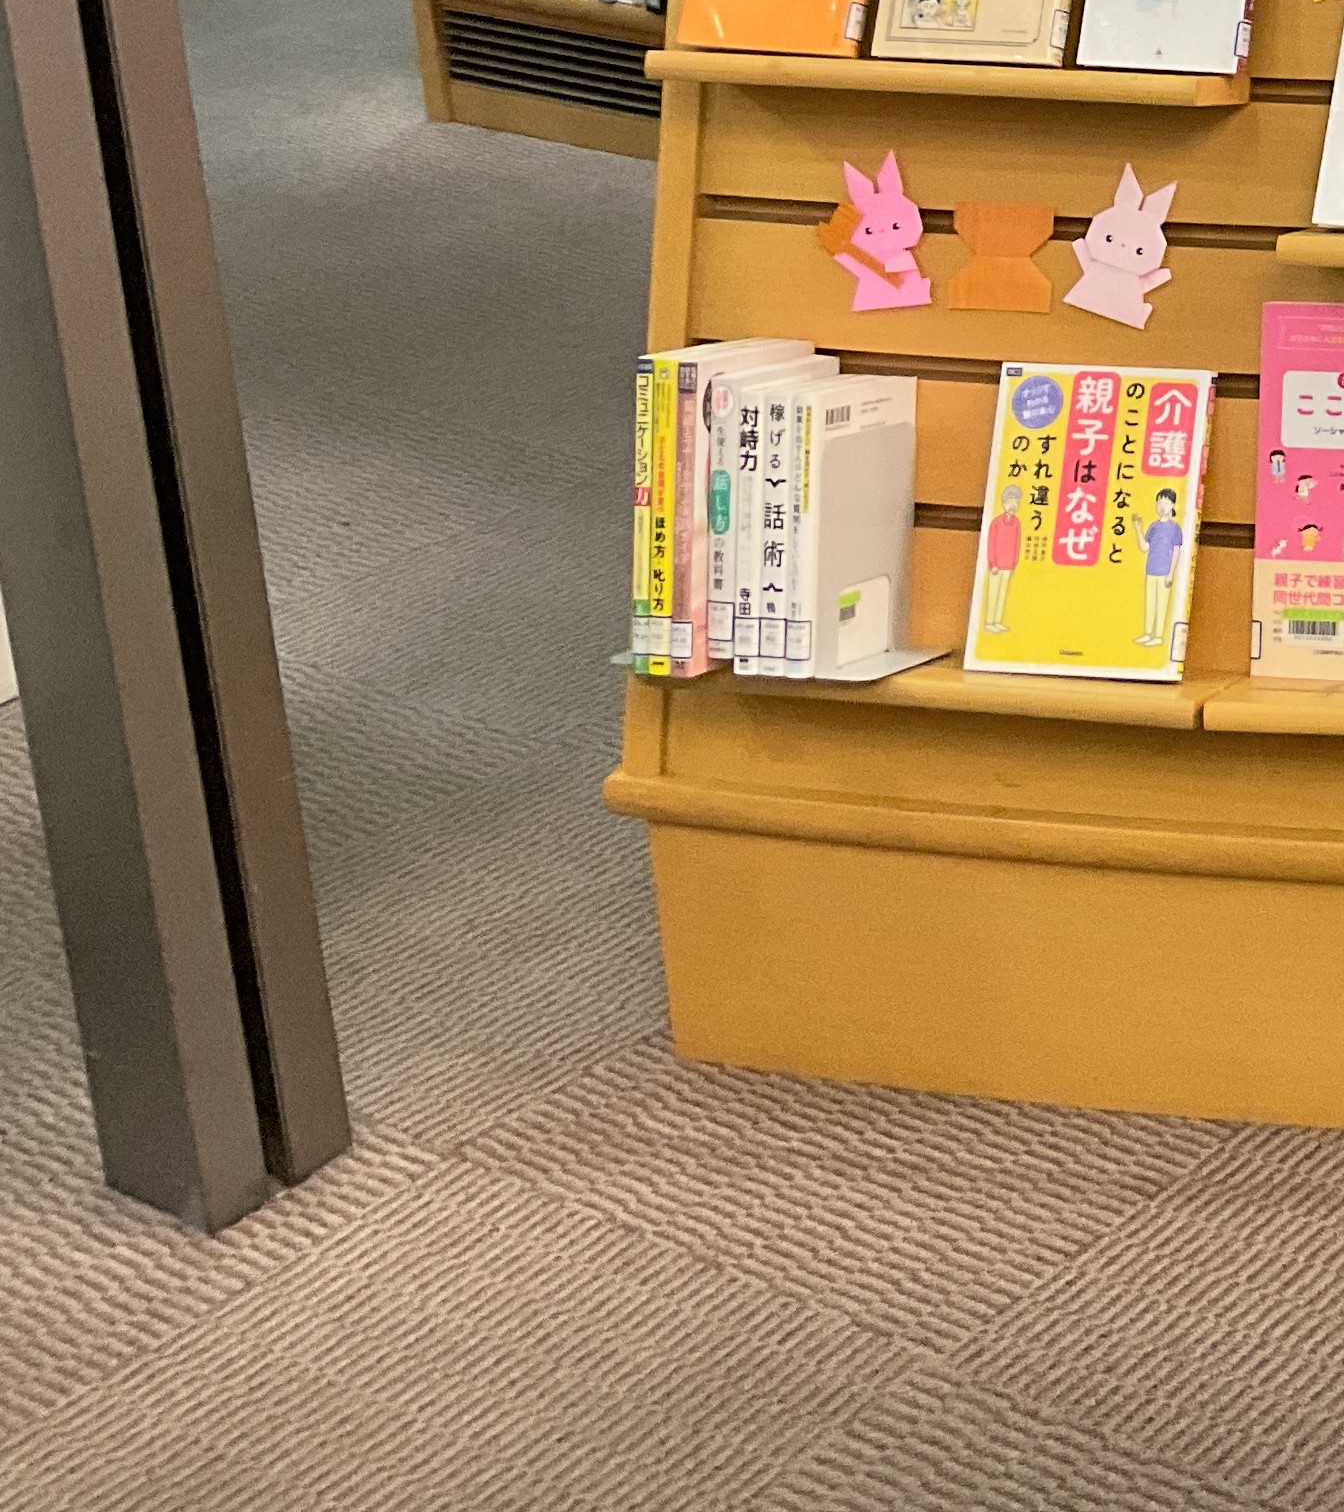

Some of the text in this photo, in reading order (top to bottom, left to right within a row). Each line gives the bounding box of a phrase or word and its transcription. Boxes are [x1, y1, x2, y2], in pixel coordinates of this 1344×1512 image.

[762, 402, 787, 569] 稼げる 話術
[1007, 434, 1031, 478] のか
[1029, 434, 1057, 531] すれ違う
[1058, 376, 1115, 561] 親子はなぜ
[1108, 381, 1146, 565] のことになると
[1148, 388, 1193, 470] 介護
